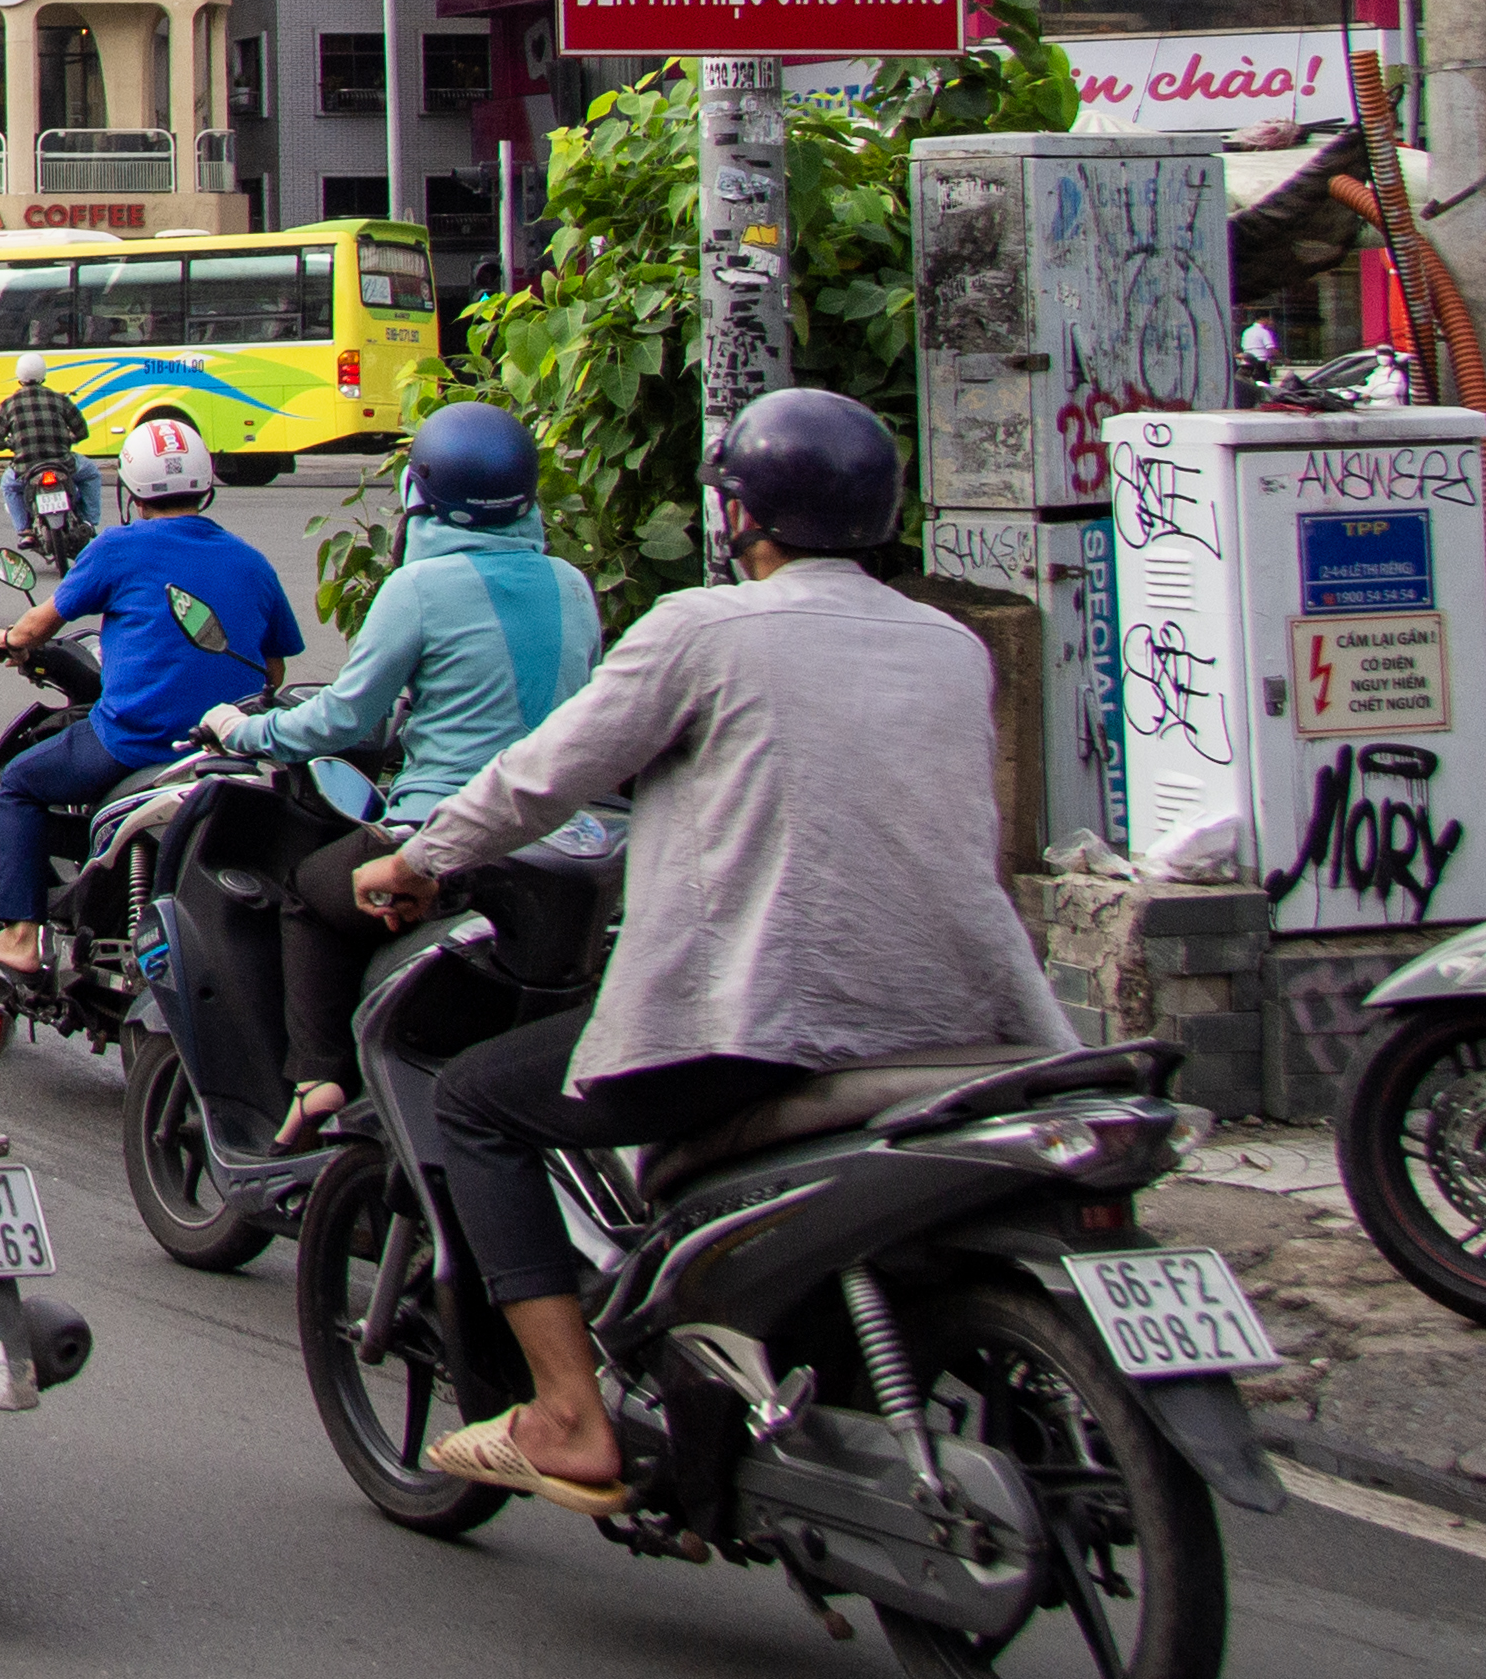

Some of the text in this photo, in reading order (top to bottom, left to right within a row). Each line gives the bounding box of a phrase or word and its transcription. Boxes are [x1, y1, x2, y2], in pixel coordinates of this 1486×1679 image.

[1144, 52, 1324, 102] chào!
[24, 203, 147, 229] COFFEE
[143, 358, 206, 376] 51B-071.90
[1084, 528, 1117, 711] SPECIAL
[1336, 631, 1368, 649] CẤM
[1350, 678, 1390, 693] NGUY
[1095, 1257, 1222, 1309] 66-F2
[1113, 1309, 1260, 1365] 098.21
